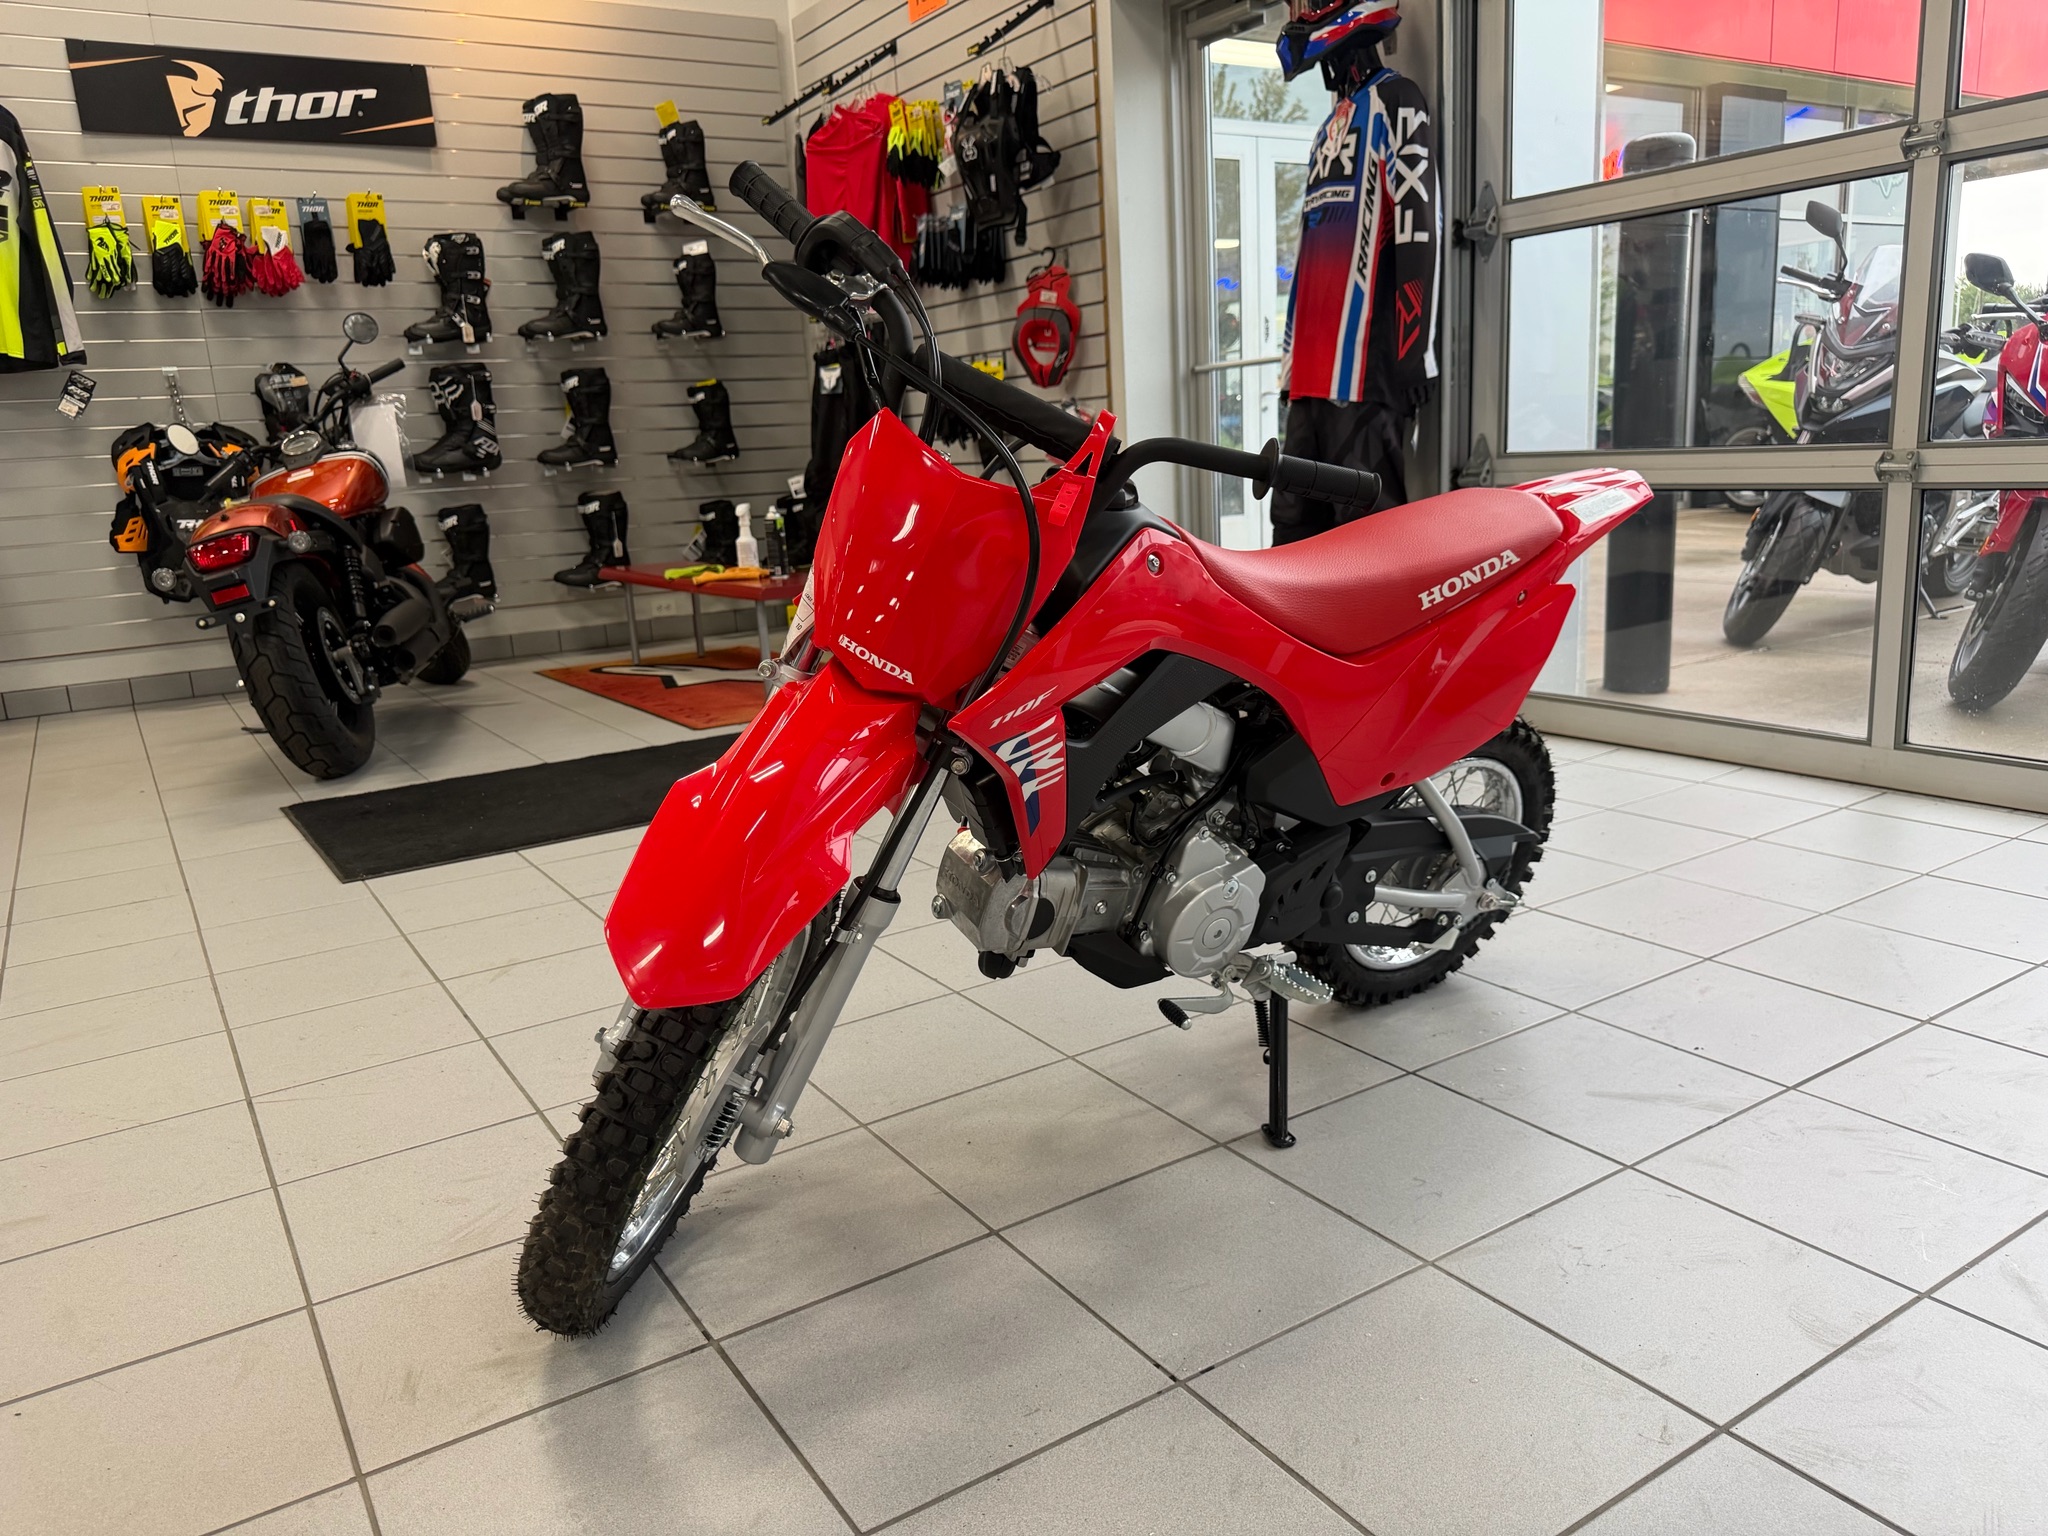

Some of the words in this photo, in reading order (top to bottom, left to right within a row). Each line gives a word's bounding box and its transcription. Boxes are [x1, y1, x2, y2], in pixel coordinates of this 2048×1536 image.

[225, 86, 378, 125] thor
[1308, 132, 1358, 185] XR
[1394, 107, 1431, 245] FXR
[301, 205, 325, 213] THOR
[1356, 152, 1379, 282] RACING
[163, 229, 180, 245] THOR
[146, 460, 160, 486] THOR
[1418, 549, 1521, 611] HONDA
[839, 634, 915, 685] HONDA
[989, 684, 1060, 730] 110F
